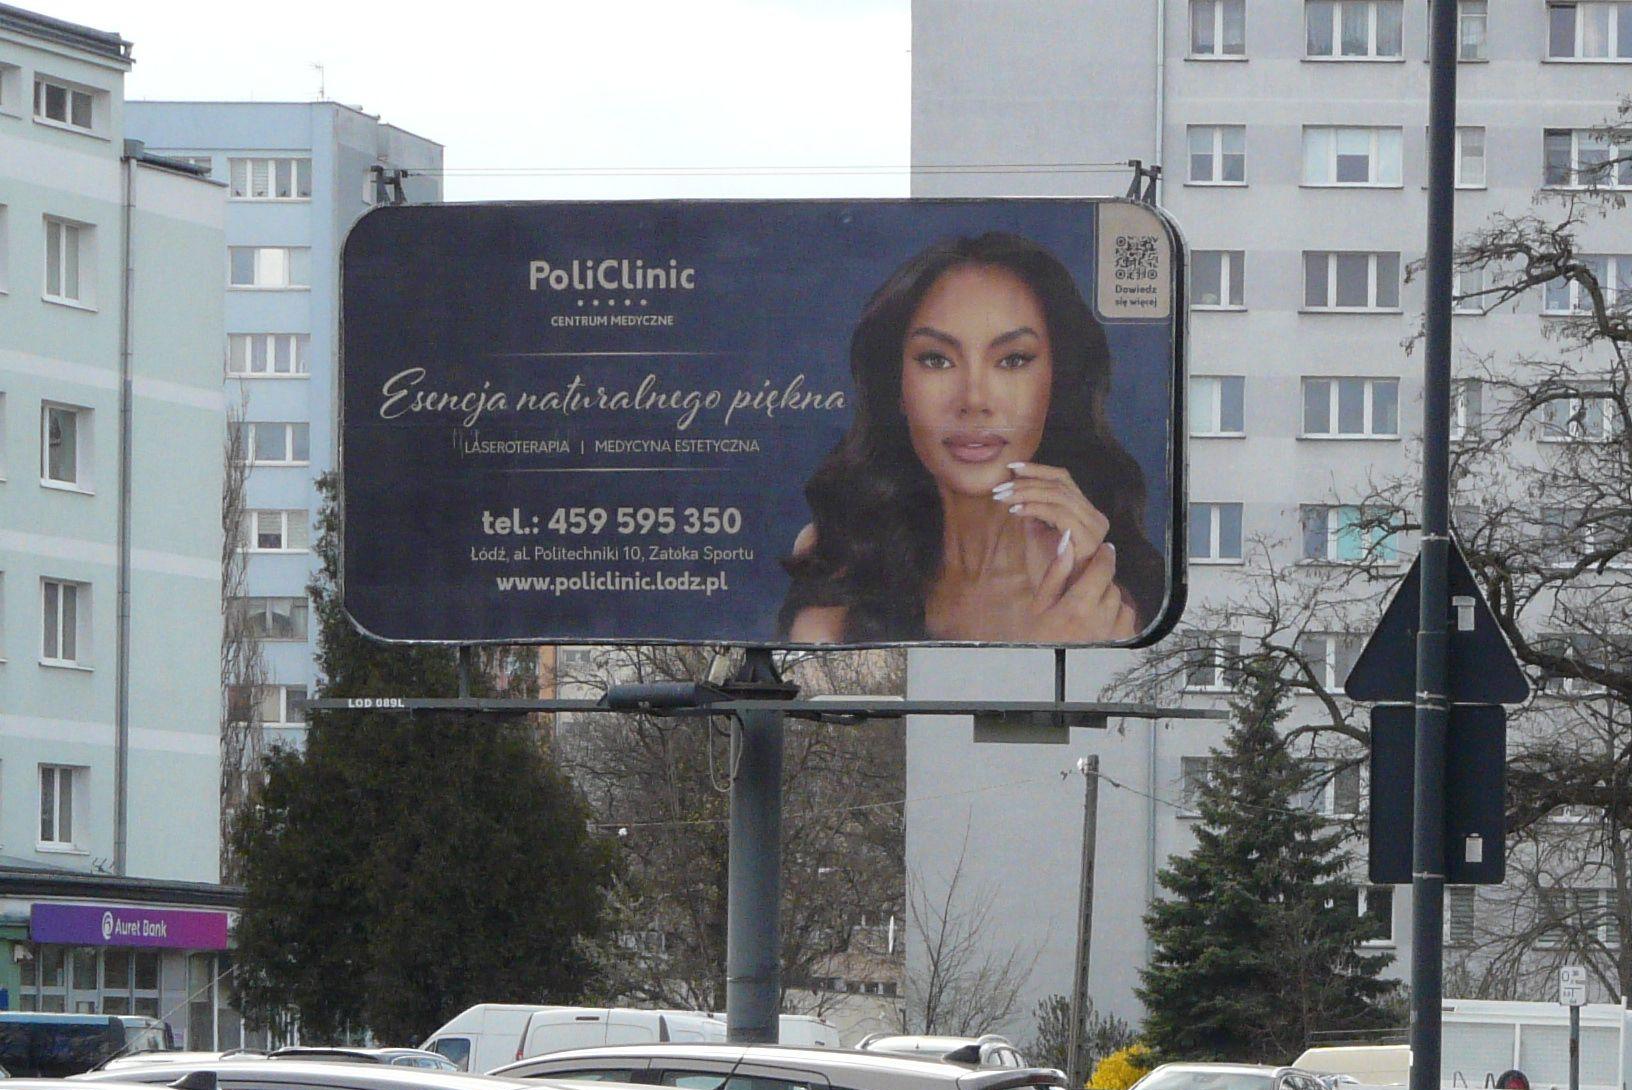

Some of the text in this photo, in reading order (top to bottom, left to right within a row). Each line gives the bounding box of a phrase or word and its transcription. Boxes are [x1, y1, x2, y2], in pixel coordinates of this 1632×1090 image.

[529, 259, 695, 290] PoliClinic
[1115, 284, 1158, 294] Dowiedz
[551, 315, 675, 327] CENTRUM MEDYCZNE
[379, 367, 847, 430] Esencja naturalnego piękna
[464, 439, 760, 453] LASEROTERAPIA MEDYCYNA ESTETYCZNA
[482, 507, 742, 535] tel.: 459 595 350
[470, 546, 754, 565] Łódź, al. Politechniki 10, Zatoka Sportu
[496, 571, 728, 596] www.policlinic.lodz.pl
[348, 698, 405, 708] LOD 089L
[114, 918, 167, 937] Auret Bank
